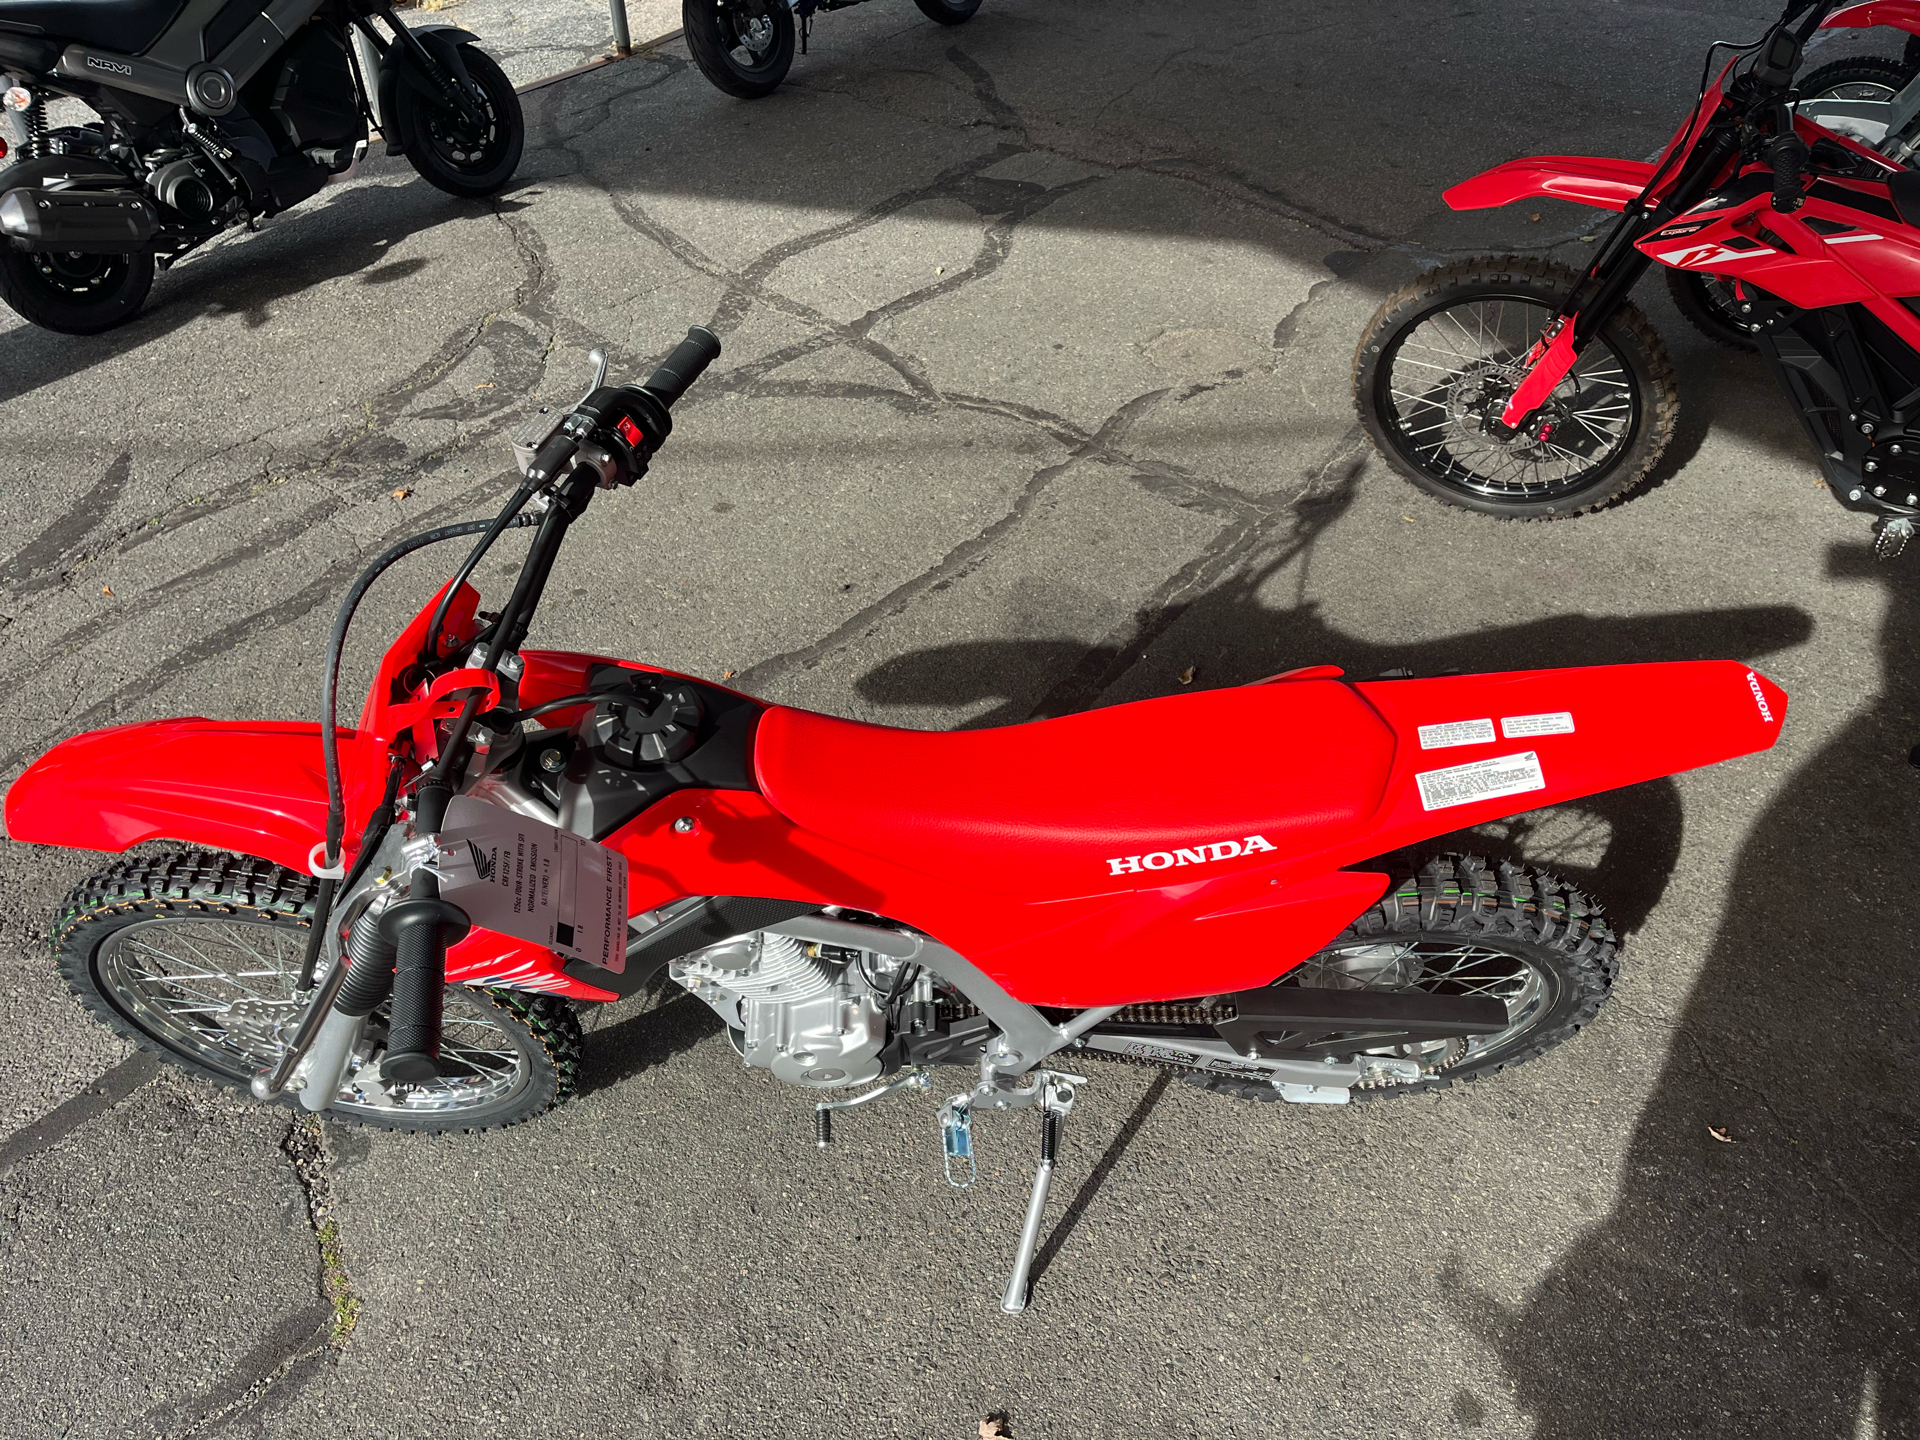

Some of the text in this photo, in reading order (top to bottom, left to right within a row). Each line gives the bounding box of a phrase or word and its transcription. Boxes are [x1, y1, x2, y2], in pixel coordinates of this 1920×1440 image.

[88, 56, 132, 75] NAVI
[1746, 671, 1774, 722] HONDA
[490, 847, 498, 883] HONDA
[1106, 835, 1277, 876] HONDA
[528, 874, 536, 912] NORMALIZED
[602, 886, 612, 965] PERFORMANCE
